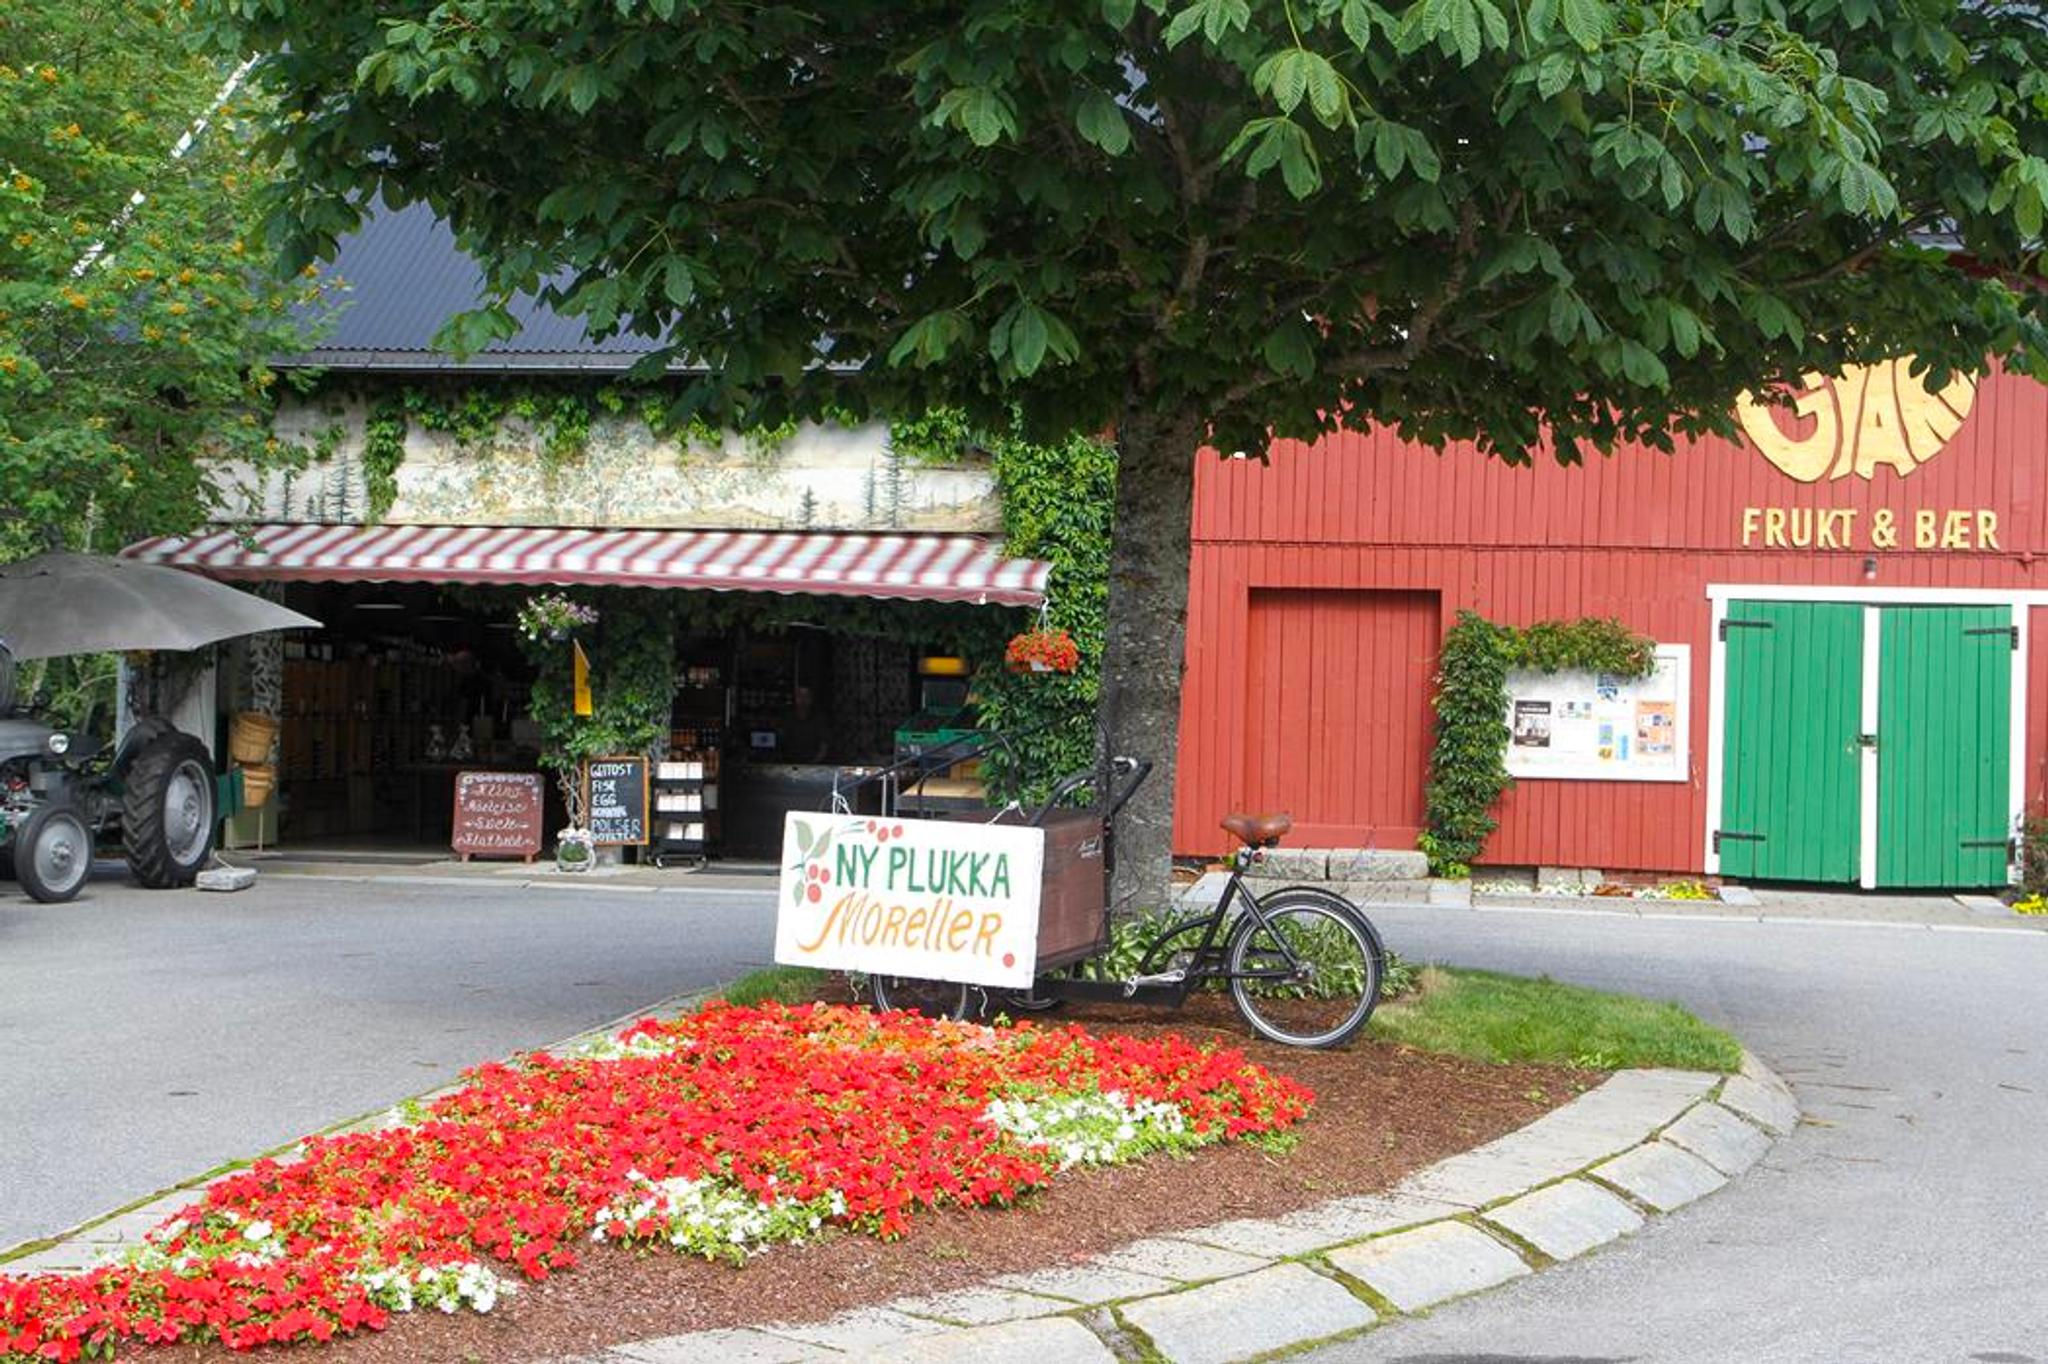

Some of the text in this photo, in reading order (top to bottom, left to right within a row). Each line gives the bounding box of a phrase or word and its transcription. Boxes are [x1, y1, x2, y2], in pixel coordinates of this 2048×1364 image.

[1742, 507, 2000, 551] FRUKT & BÆR
[592, 793, 617, 806] EGG
[835, 842, 1011, 899] NY PLUKKA
